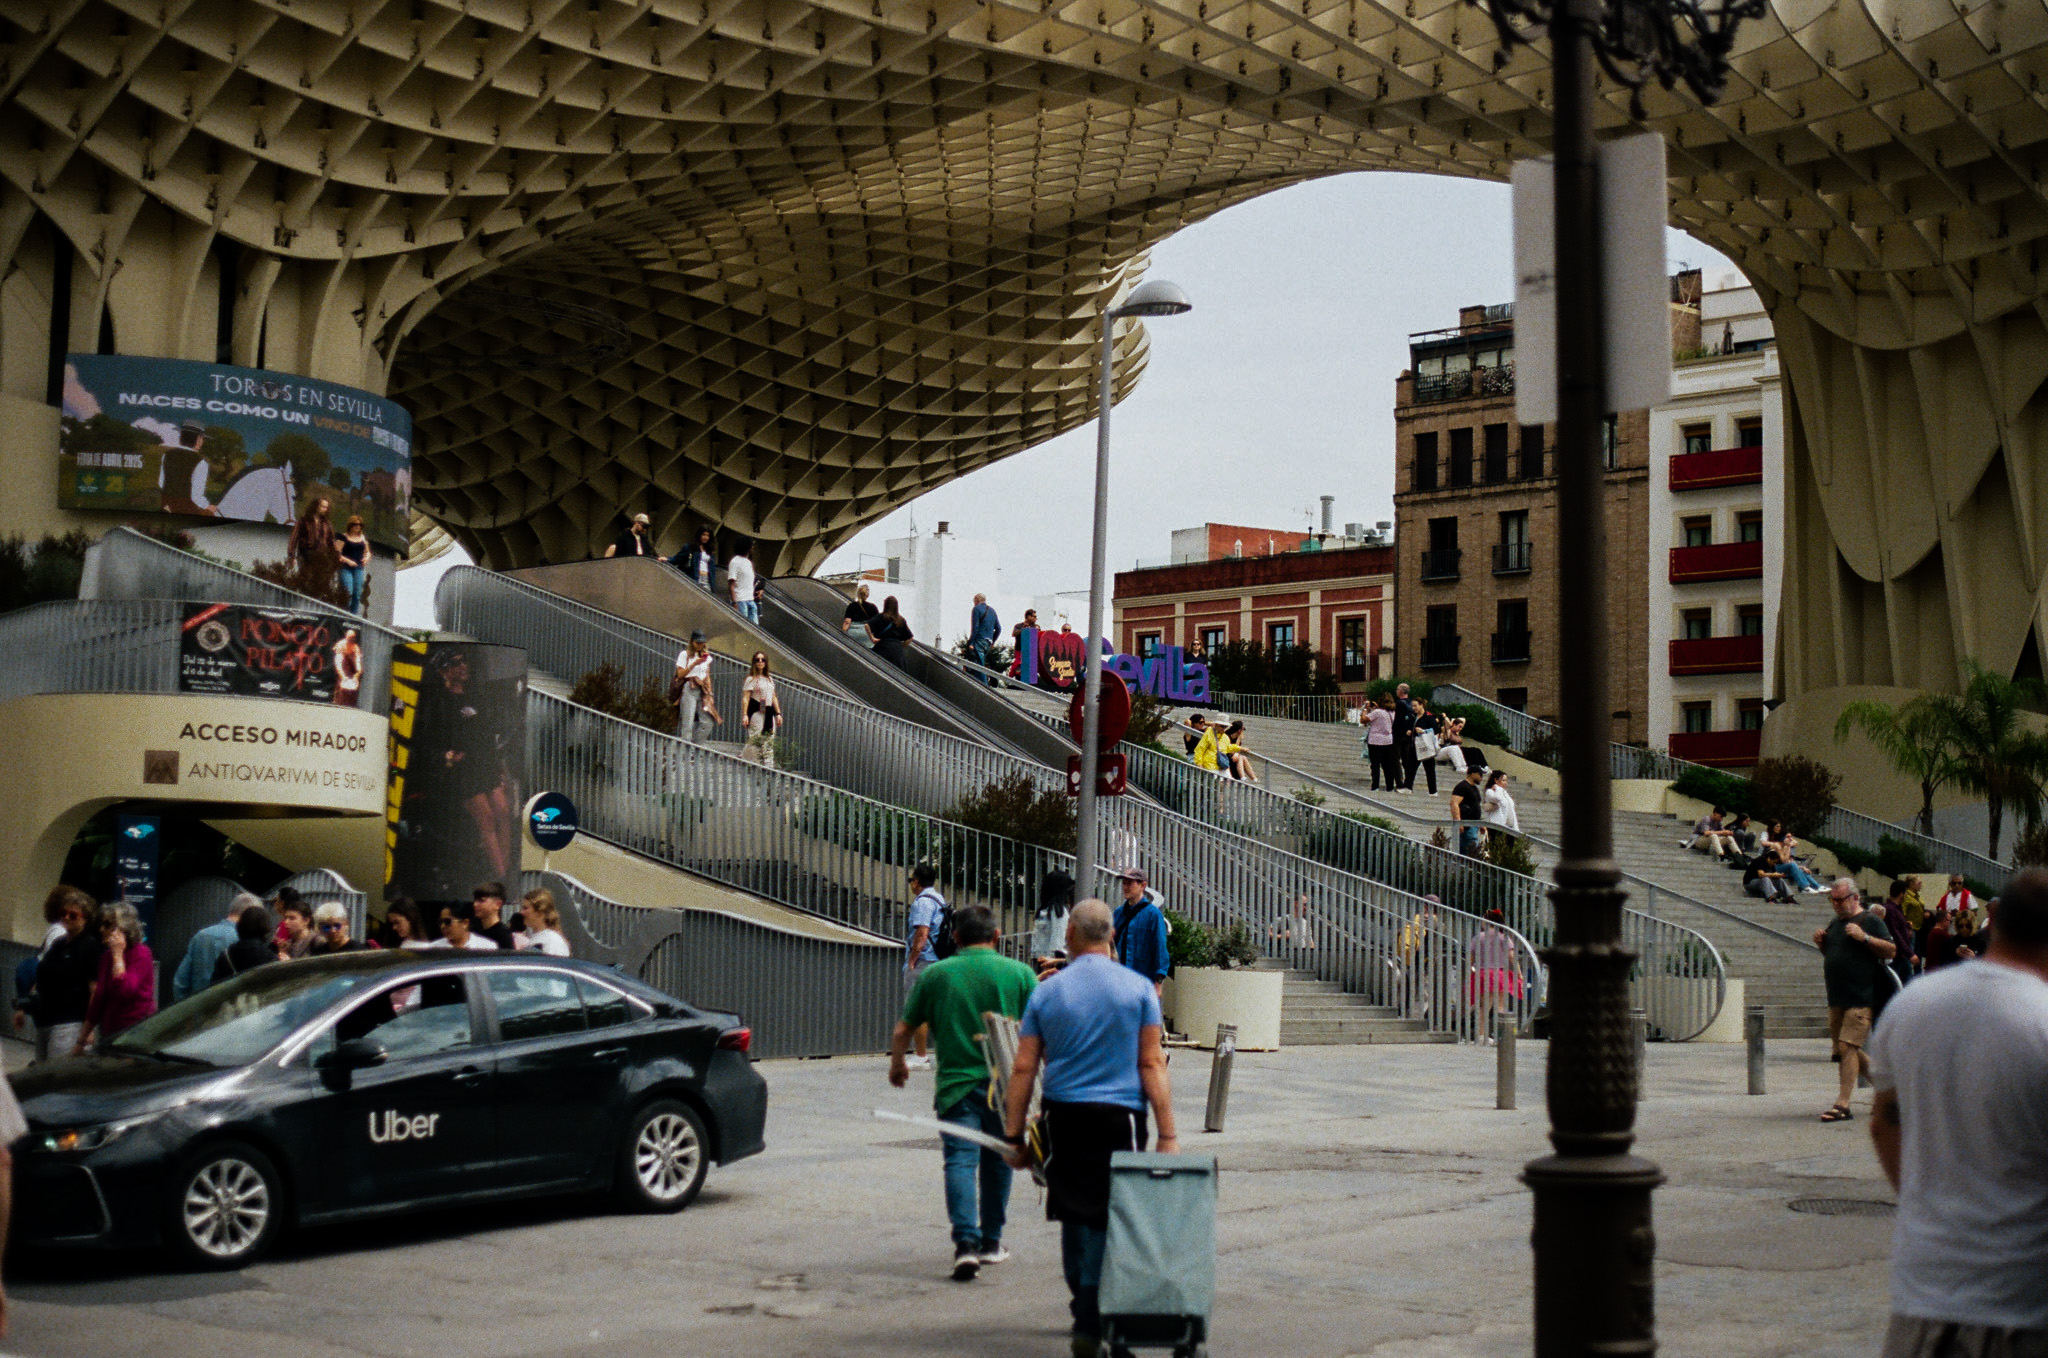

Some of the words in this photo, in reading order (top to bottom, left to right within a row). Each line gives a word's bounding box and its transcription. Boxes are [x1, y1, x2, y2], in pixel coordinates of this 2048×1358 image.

[118, 393, 202, 410] NACES
[206, 400, 278, 420] COMO
[282, 409, 309, 425] UN
[210, 374, 292, 402] TOROS
[299, 387, 323, 407] EN
[328, 395, 384, 423] SEVILLA
[124, 454, 143, 469] 2025
[240, 617, 330, 648] PONCIO
[246, 646, 325, 690] PILATO
[1020, 627, 1038, 685] I
[179, 722, 278, 745] ACCESO
[285, 729, 367, 753] MIRADOR
[188, 762, 318, 787] ANTIQVARIVM
[322, 770, 340, 788] DE
[368, 1110, 440, 1144] Uber
